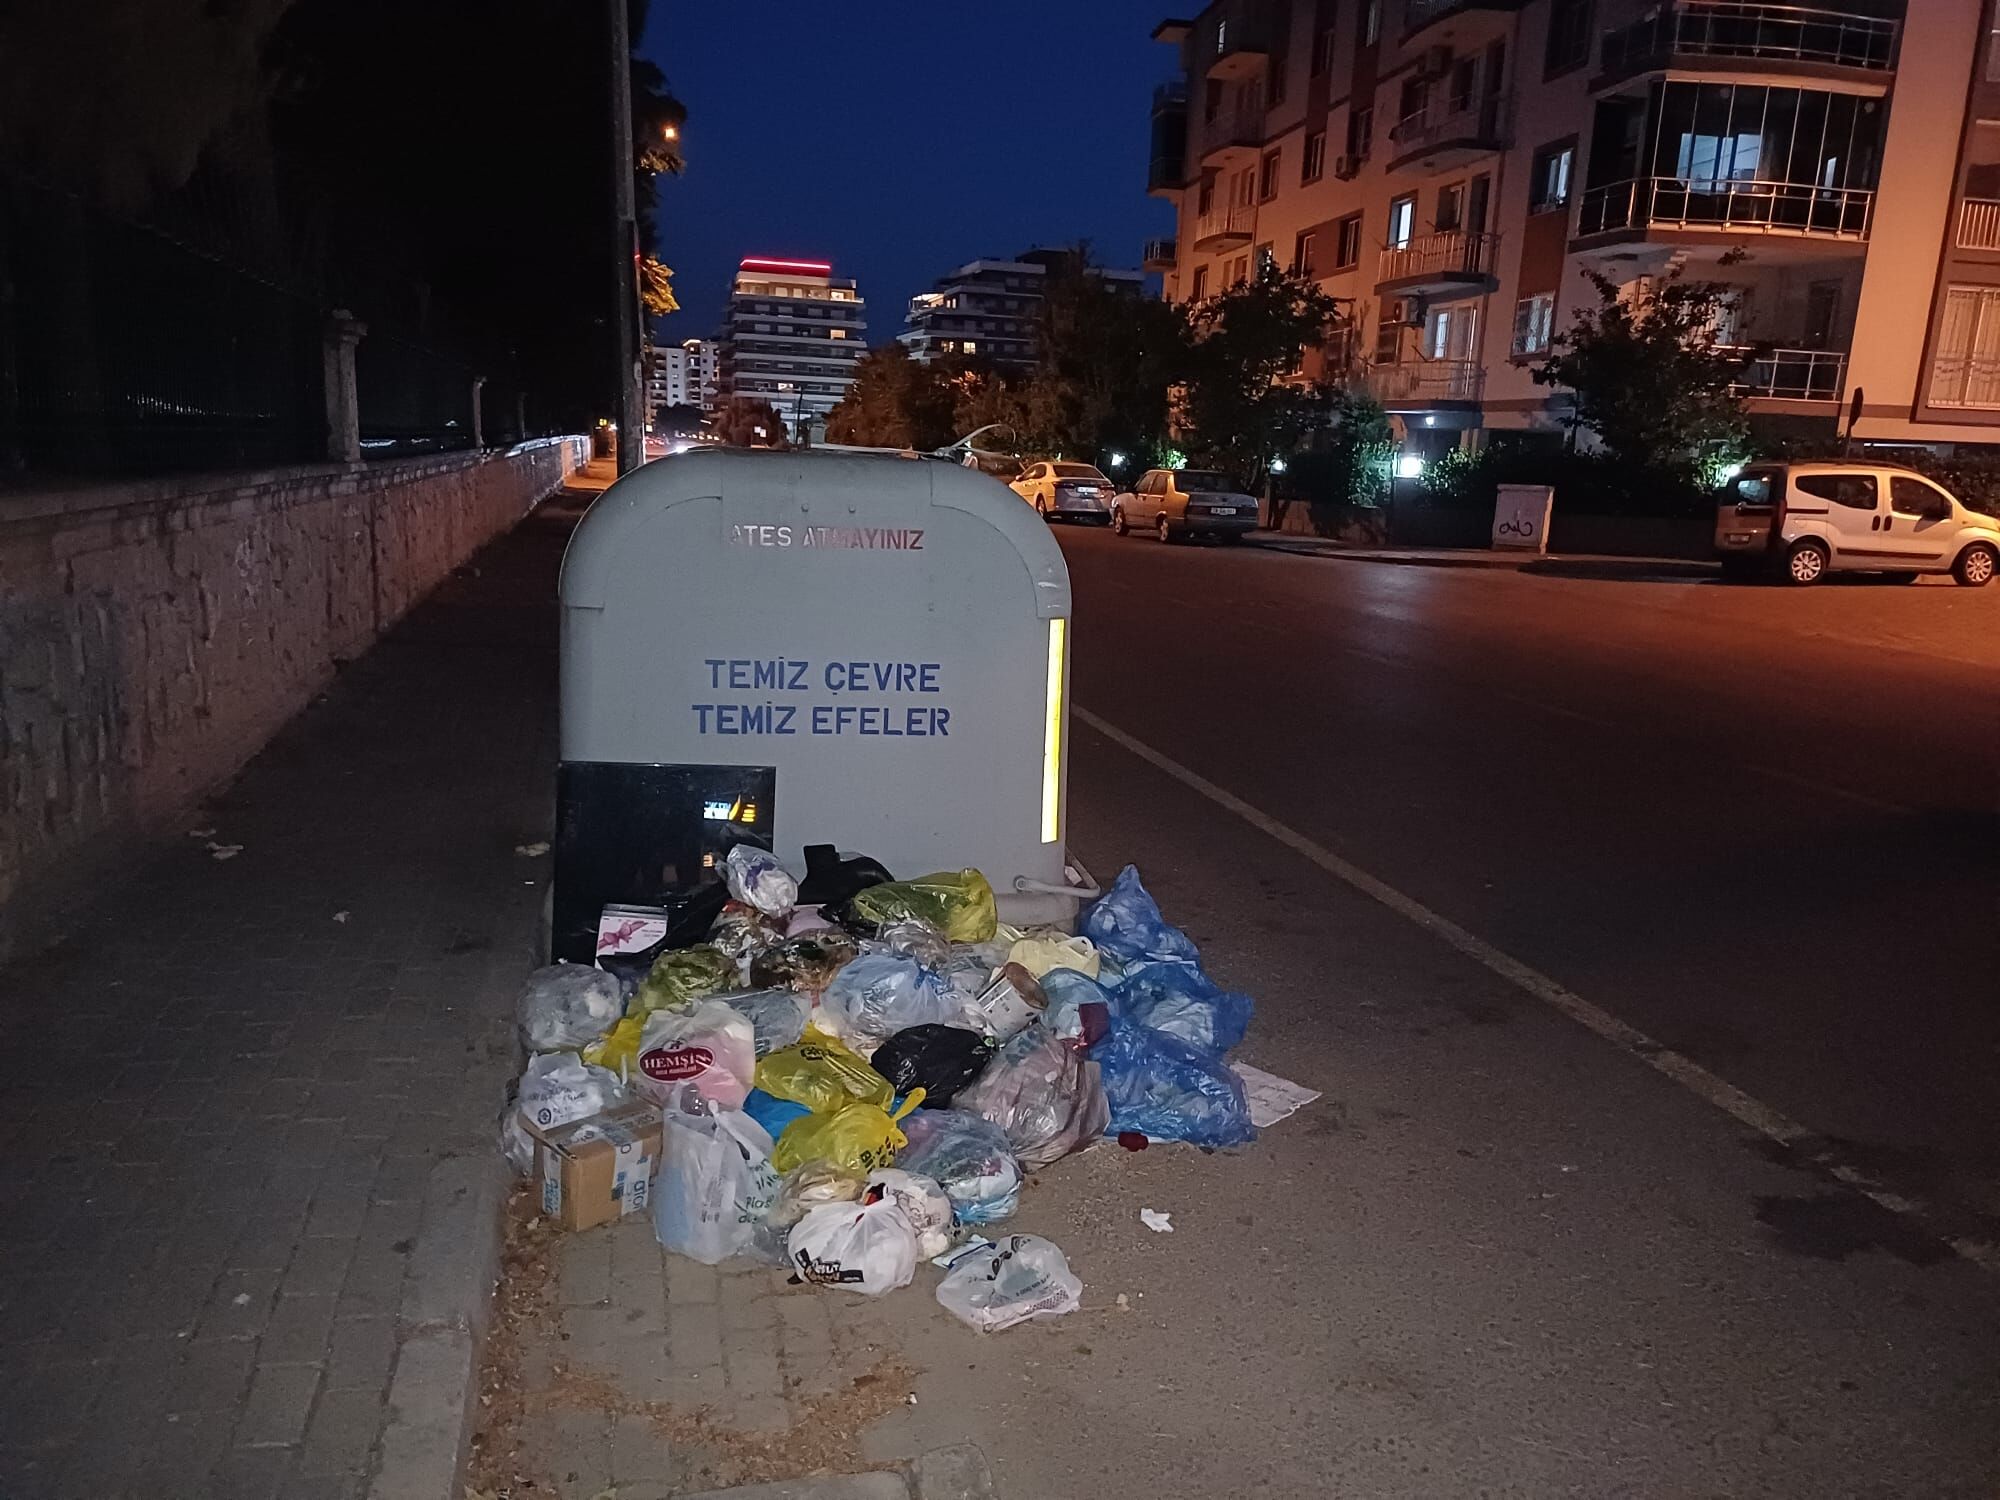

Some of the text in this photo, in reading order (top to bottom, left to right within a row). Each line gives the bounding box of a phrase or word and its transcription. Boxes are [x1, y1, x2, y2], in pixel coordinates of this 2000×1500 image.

[704, 656, 940, 696] TEMİZ ÇEVRE
[692, 701, 951, 736] TEMİZ EFELER
